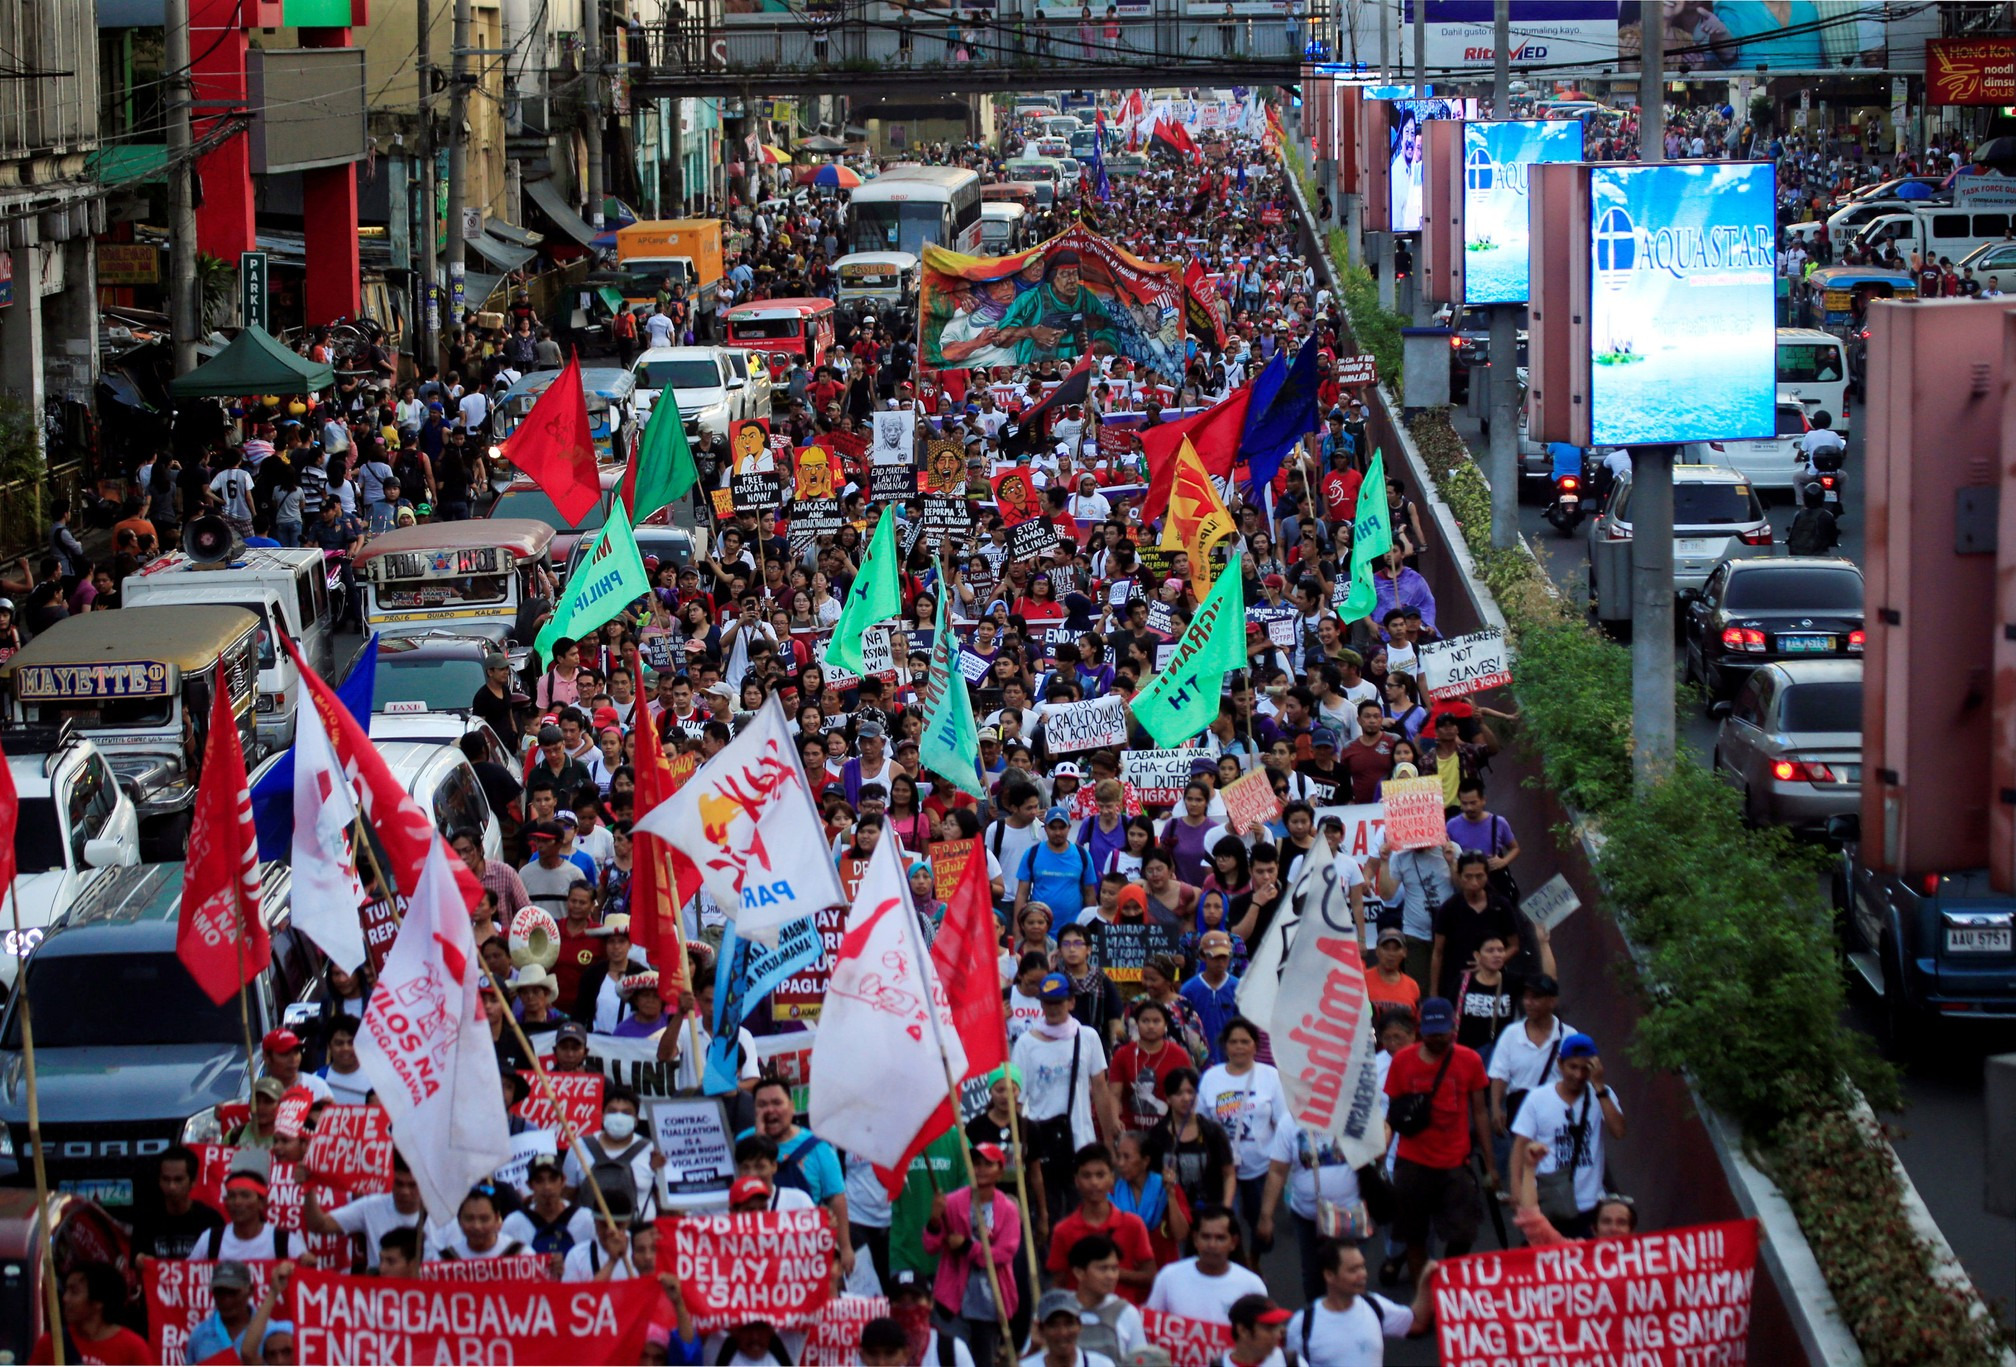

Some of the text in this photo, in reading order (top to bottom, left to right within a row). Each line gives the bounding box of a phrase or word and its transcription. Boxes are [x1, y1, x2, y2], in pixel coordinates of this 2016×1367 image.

[1441, 27, 1582, 38] Dahil gusto gumaling kayo.
[1950, 46, 1987, 59] HONG
[1639, 225, 1775, 279] AQUASTAR
[742, 474, 763, 485] FREE
[870, 468, 885, 477] END
[226, 479, 238, 500] 6
[734, 482, 779, 495] EDUCATION
[747, 491, 772, 503] NOW!
[923, 499, 966, 509] TUNAY NA
[793, 502, 838, 512] WAKASAN
[923, 508, 968, 518] REPORMA SA
[1016, 520, 1040, 536] STOP
[1013, 527, 1046, 546] LUMAD
[1013, 532, 1057, 557] KILLINGS!
[383, 552, 426, 579] PHIL
[456, 547, 499, 575] RICH
[1151, 600, 1171, 613] STOP
[426, 611, 455, 620] QUIAPO
[865, 632, 883, 648] NA
[1421, 628, 1502, 656] WE ARE WORKERS
[1451, 645, 1474, 664] NOT
[1447, 655, 1501, 684] SLAVES!
[19, 663, 162, 697] MAYETTE 11
[1480, 671, 1513, 688] YOUTH
[391, 703, 421, 712] TAXI
[1047, 704, 1125, 731] CRACKDOWNS
[1048, 718, 1125, 745] ON ACTIVISTS!
[1127, 748, 1212, 761] LABANAN ANG
[1128, 775, 1142, 789] NI
[1224, 773, 1264, 804] WOMEN
[1390, 804, 1437, 817] WOMEN'S
[1104, 923, 1164, 935] PAHIRAP SA
[1149, 936, 1169, 947] TAX
[1951, 932, 2008, 945] AAU 5751
[1107, 948, 1147, 959] REFORM
[414, 1056, 441, 1099] NA
[664, 1116, 712, 1126] CONTRAC-
[661, 1126, 720, 1137] TUALIZATION
[23, 1139, 170, 1158] FORD
[684, 1138, 702, 1146] IS A
[666, 1145, 727, 1157] LABOR RIGHT
[671, 1156, 727, 1169] VIOLATION!
[758, 1210, 821, 1234] LAGI
[675, 1228, 834, 1258] NA NAMANG
[157, 1261, 184, 1285] 25
[677, 1254, 828, 1284] DELAY ANG
[1436, 1281, 1618, 1322] NAG-UMPISA
[1626, 1278, 1667, 1313] NA
[295, 1280, 620, 1339] MANGGAGAWA SA
[1441, 1320, 1507, 1359] MAG
[1513, 1316, 1612, 1356] DELAY
[1622, 1312, 1665, 1349] NG
